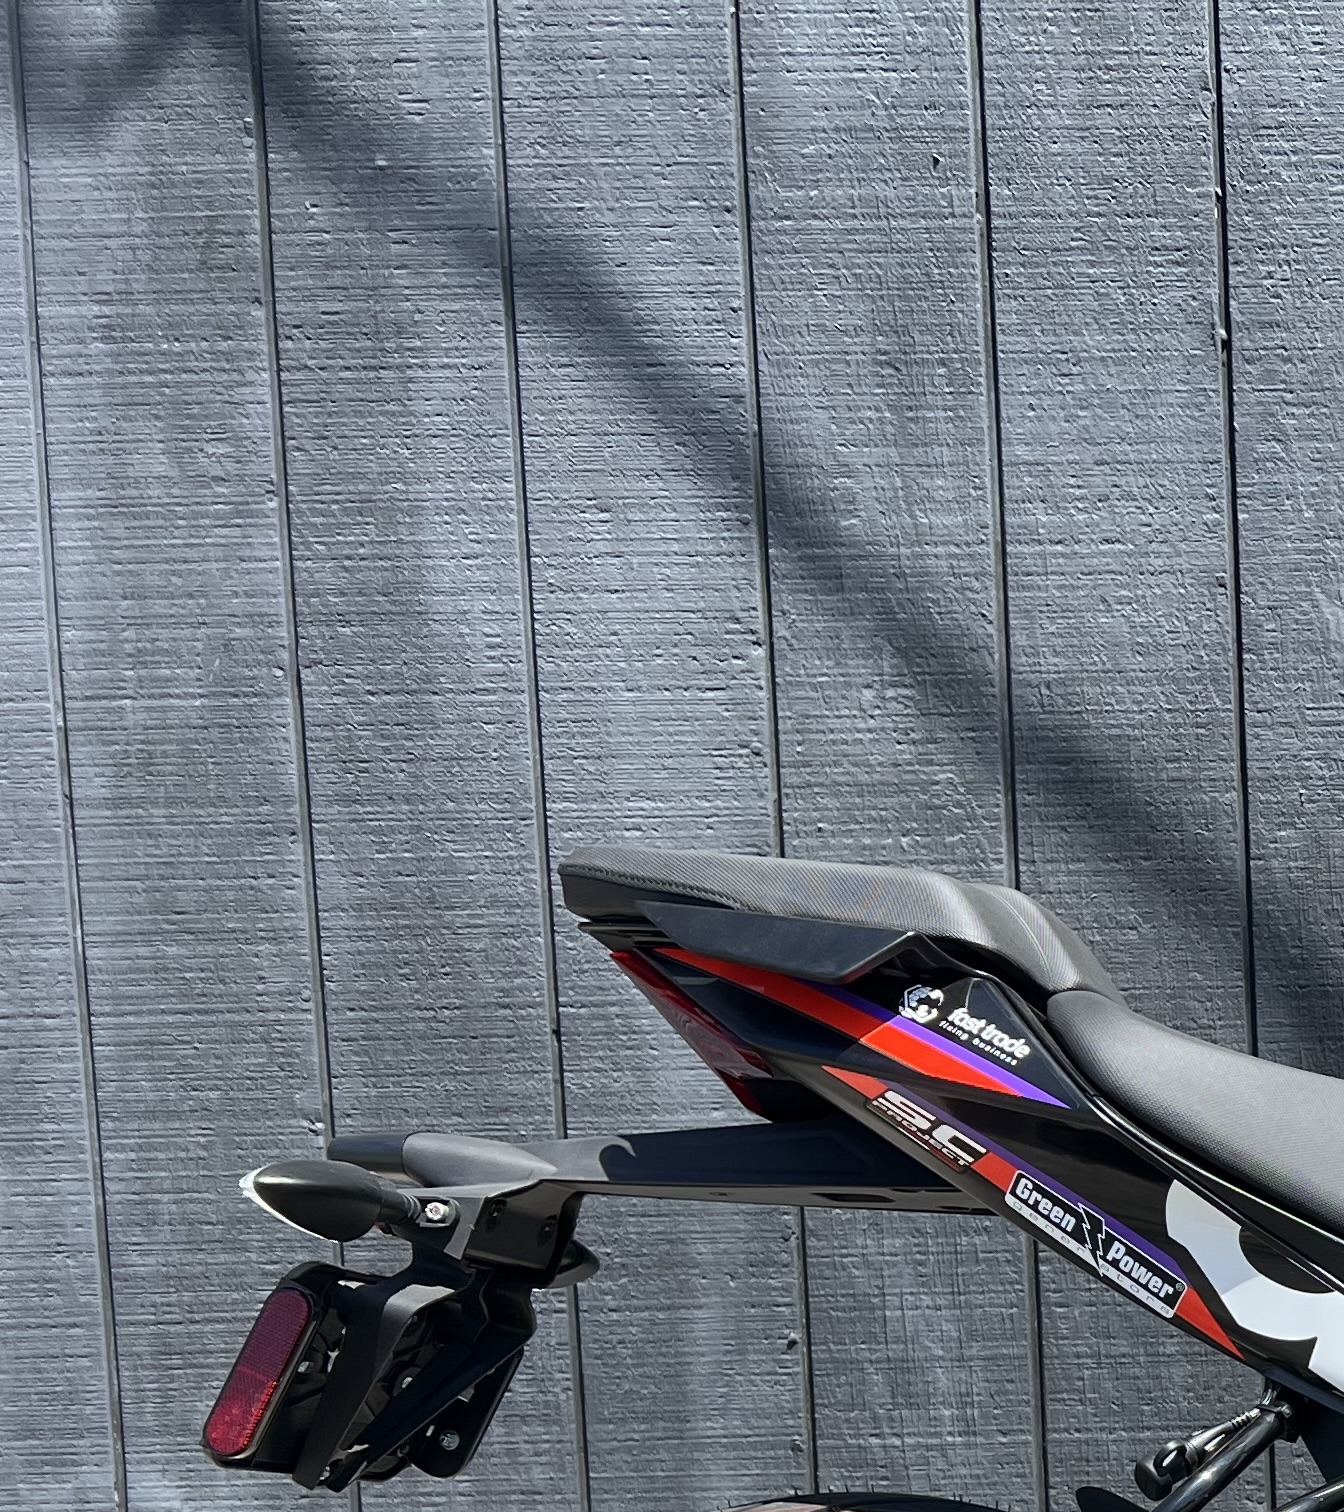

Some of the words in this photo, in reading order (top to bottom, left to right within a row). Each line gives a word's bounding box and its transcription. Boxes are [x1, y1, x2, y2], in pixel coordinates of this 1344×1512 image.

[947, 1007, 985, 1034] fast
[981, 1020, 1031, 1058] trade
[972, 1038, 1018, 1066] business
[1015, 1177, 1076, 1232] Green
[1106, 1240, 1174, 1298] Power
